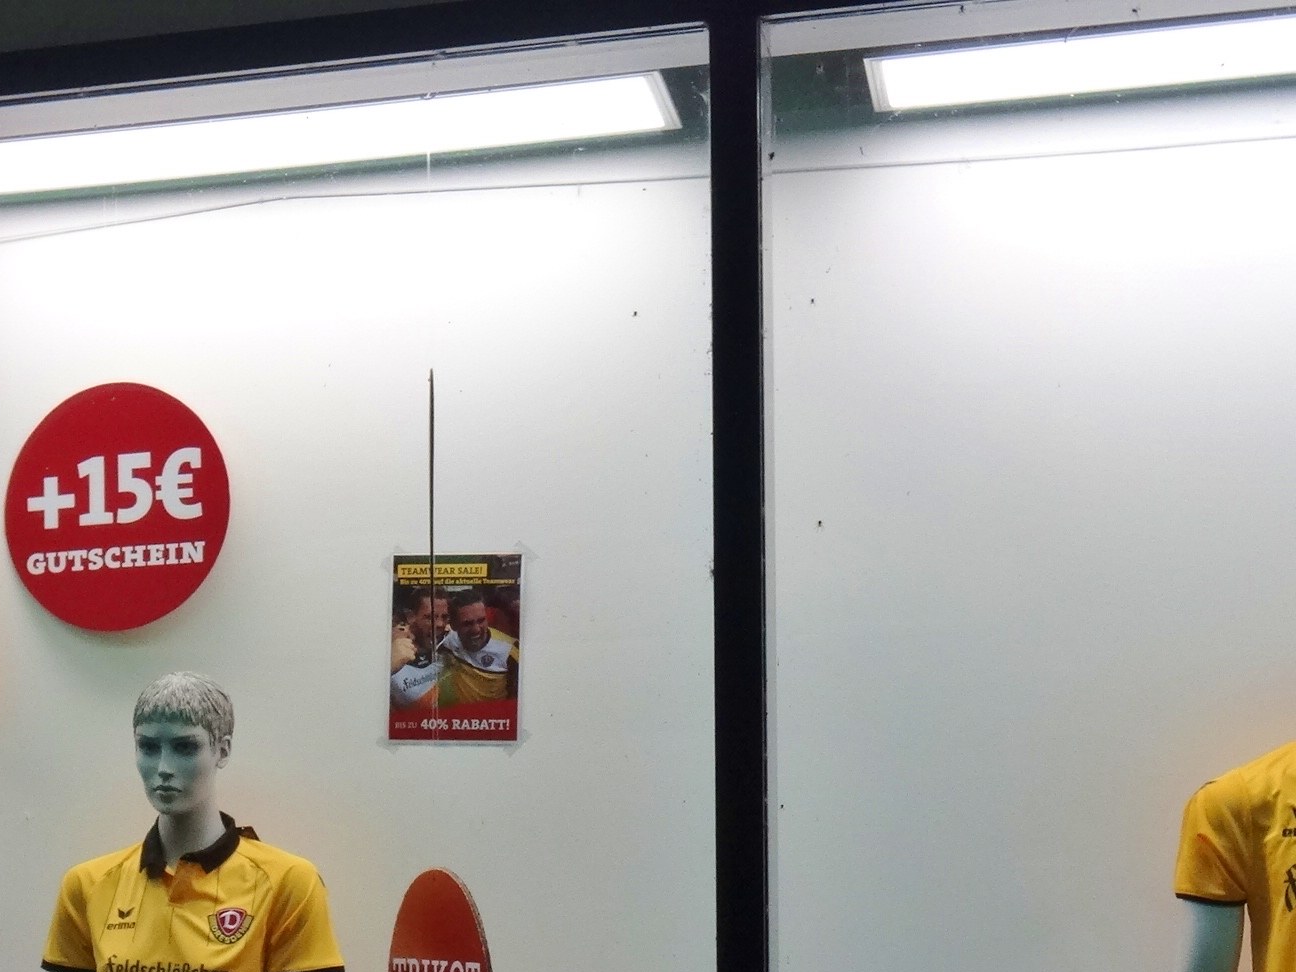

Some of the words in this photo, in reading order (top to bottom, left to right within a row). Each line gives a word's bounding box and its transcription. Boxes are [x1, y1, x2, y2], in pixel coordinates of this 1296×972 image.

[26, 446, 203, 530] +15€
[26, 541, 205, 575] GUTSCHEIN
[457, 566, 483, 575] SALE!
[420, 718, 449, 731] 40%
[451, 718, 510, 731] RABATT!
[106, 921, 136, 931] erima
